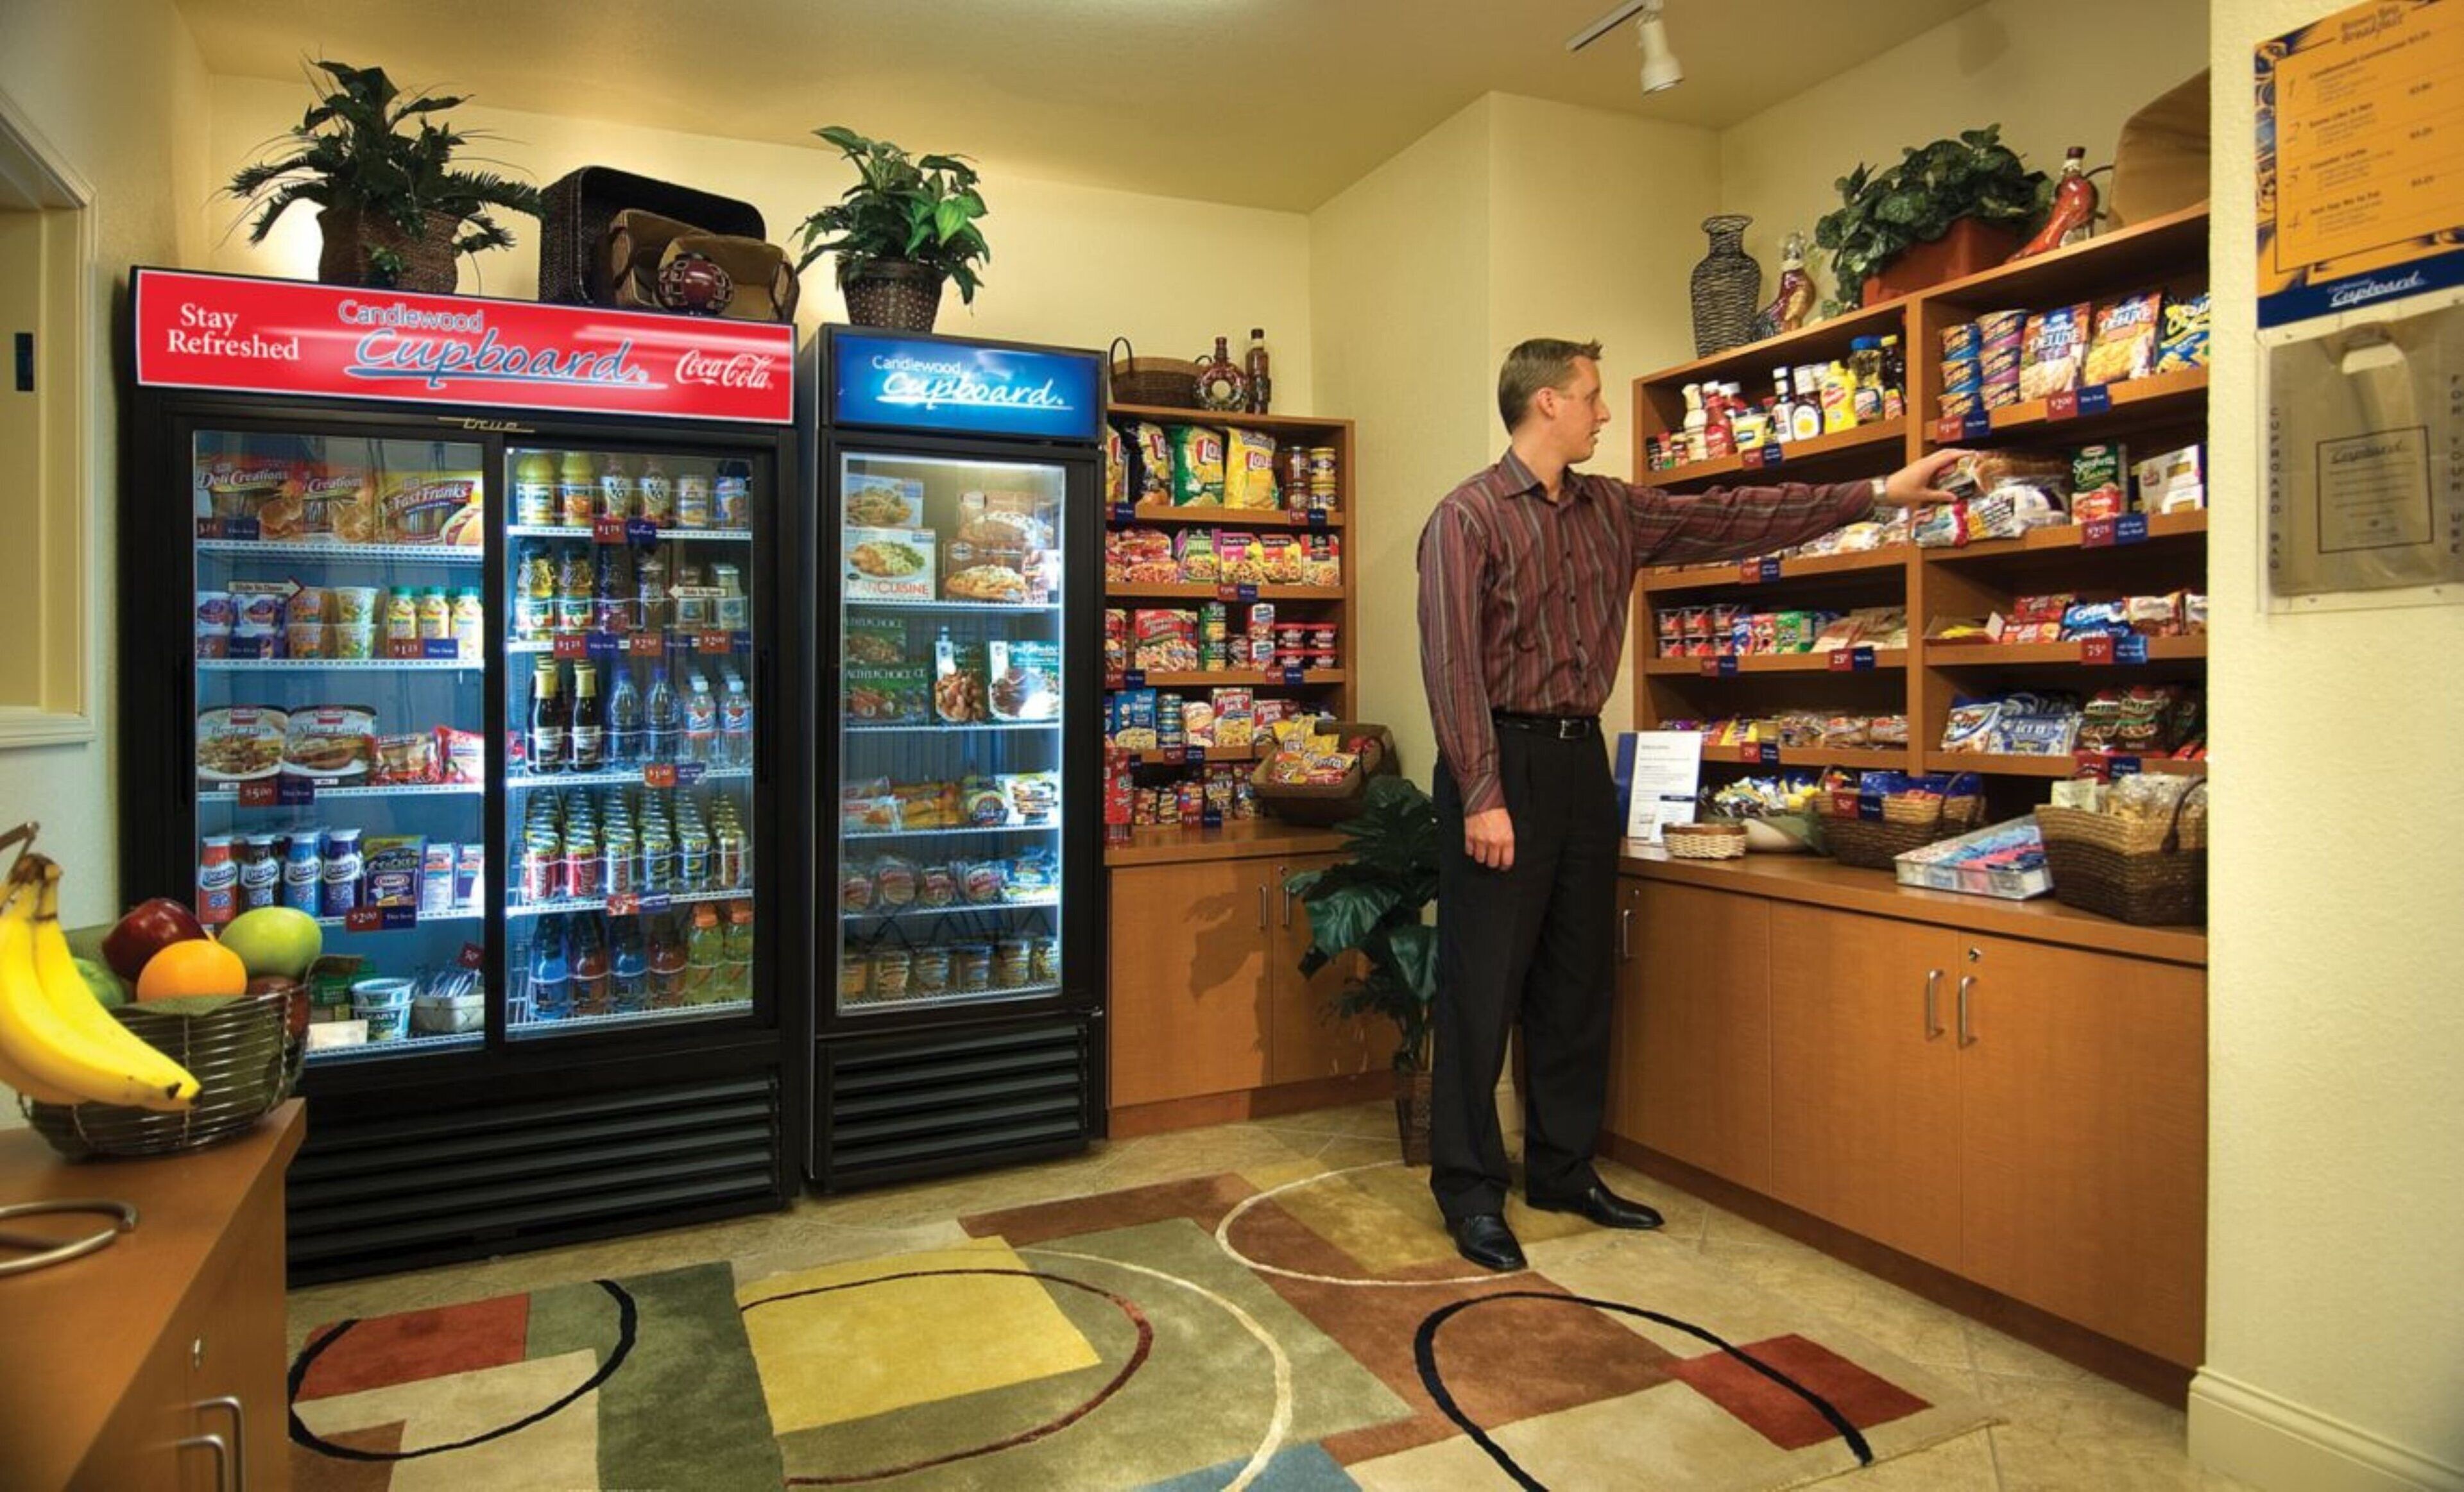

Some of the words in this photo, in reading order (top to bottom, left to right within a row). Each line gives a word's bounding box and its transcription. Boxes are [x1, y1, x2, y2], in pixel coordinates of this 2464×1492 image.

[180, 304, 239, 336] Stay
[339, 299, 484, 332] Candlewood
[167, 331, 300, 361] Refreshed
[871, 355, 962, 374] Candlewood
[201, 471, 228, 489] Deli
[230, 468, 288, 485] Creations
[307, 477, 364, 493] Creations
[393, 493, 422, 511] Fast
[422, 483, 467, 502] Franks
